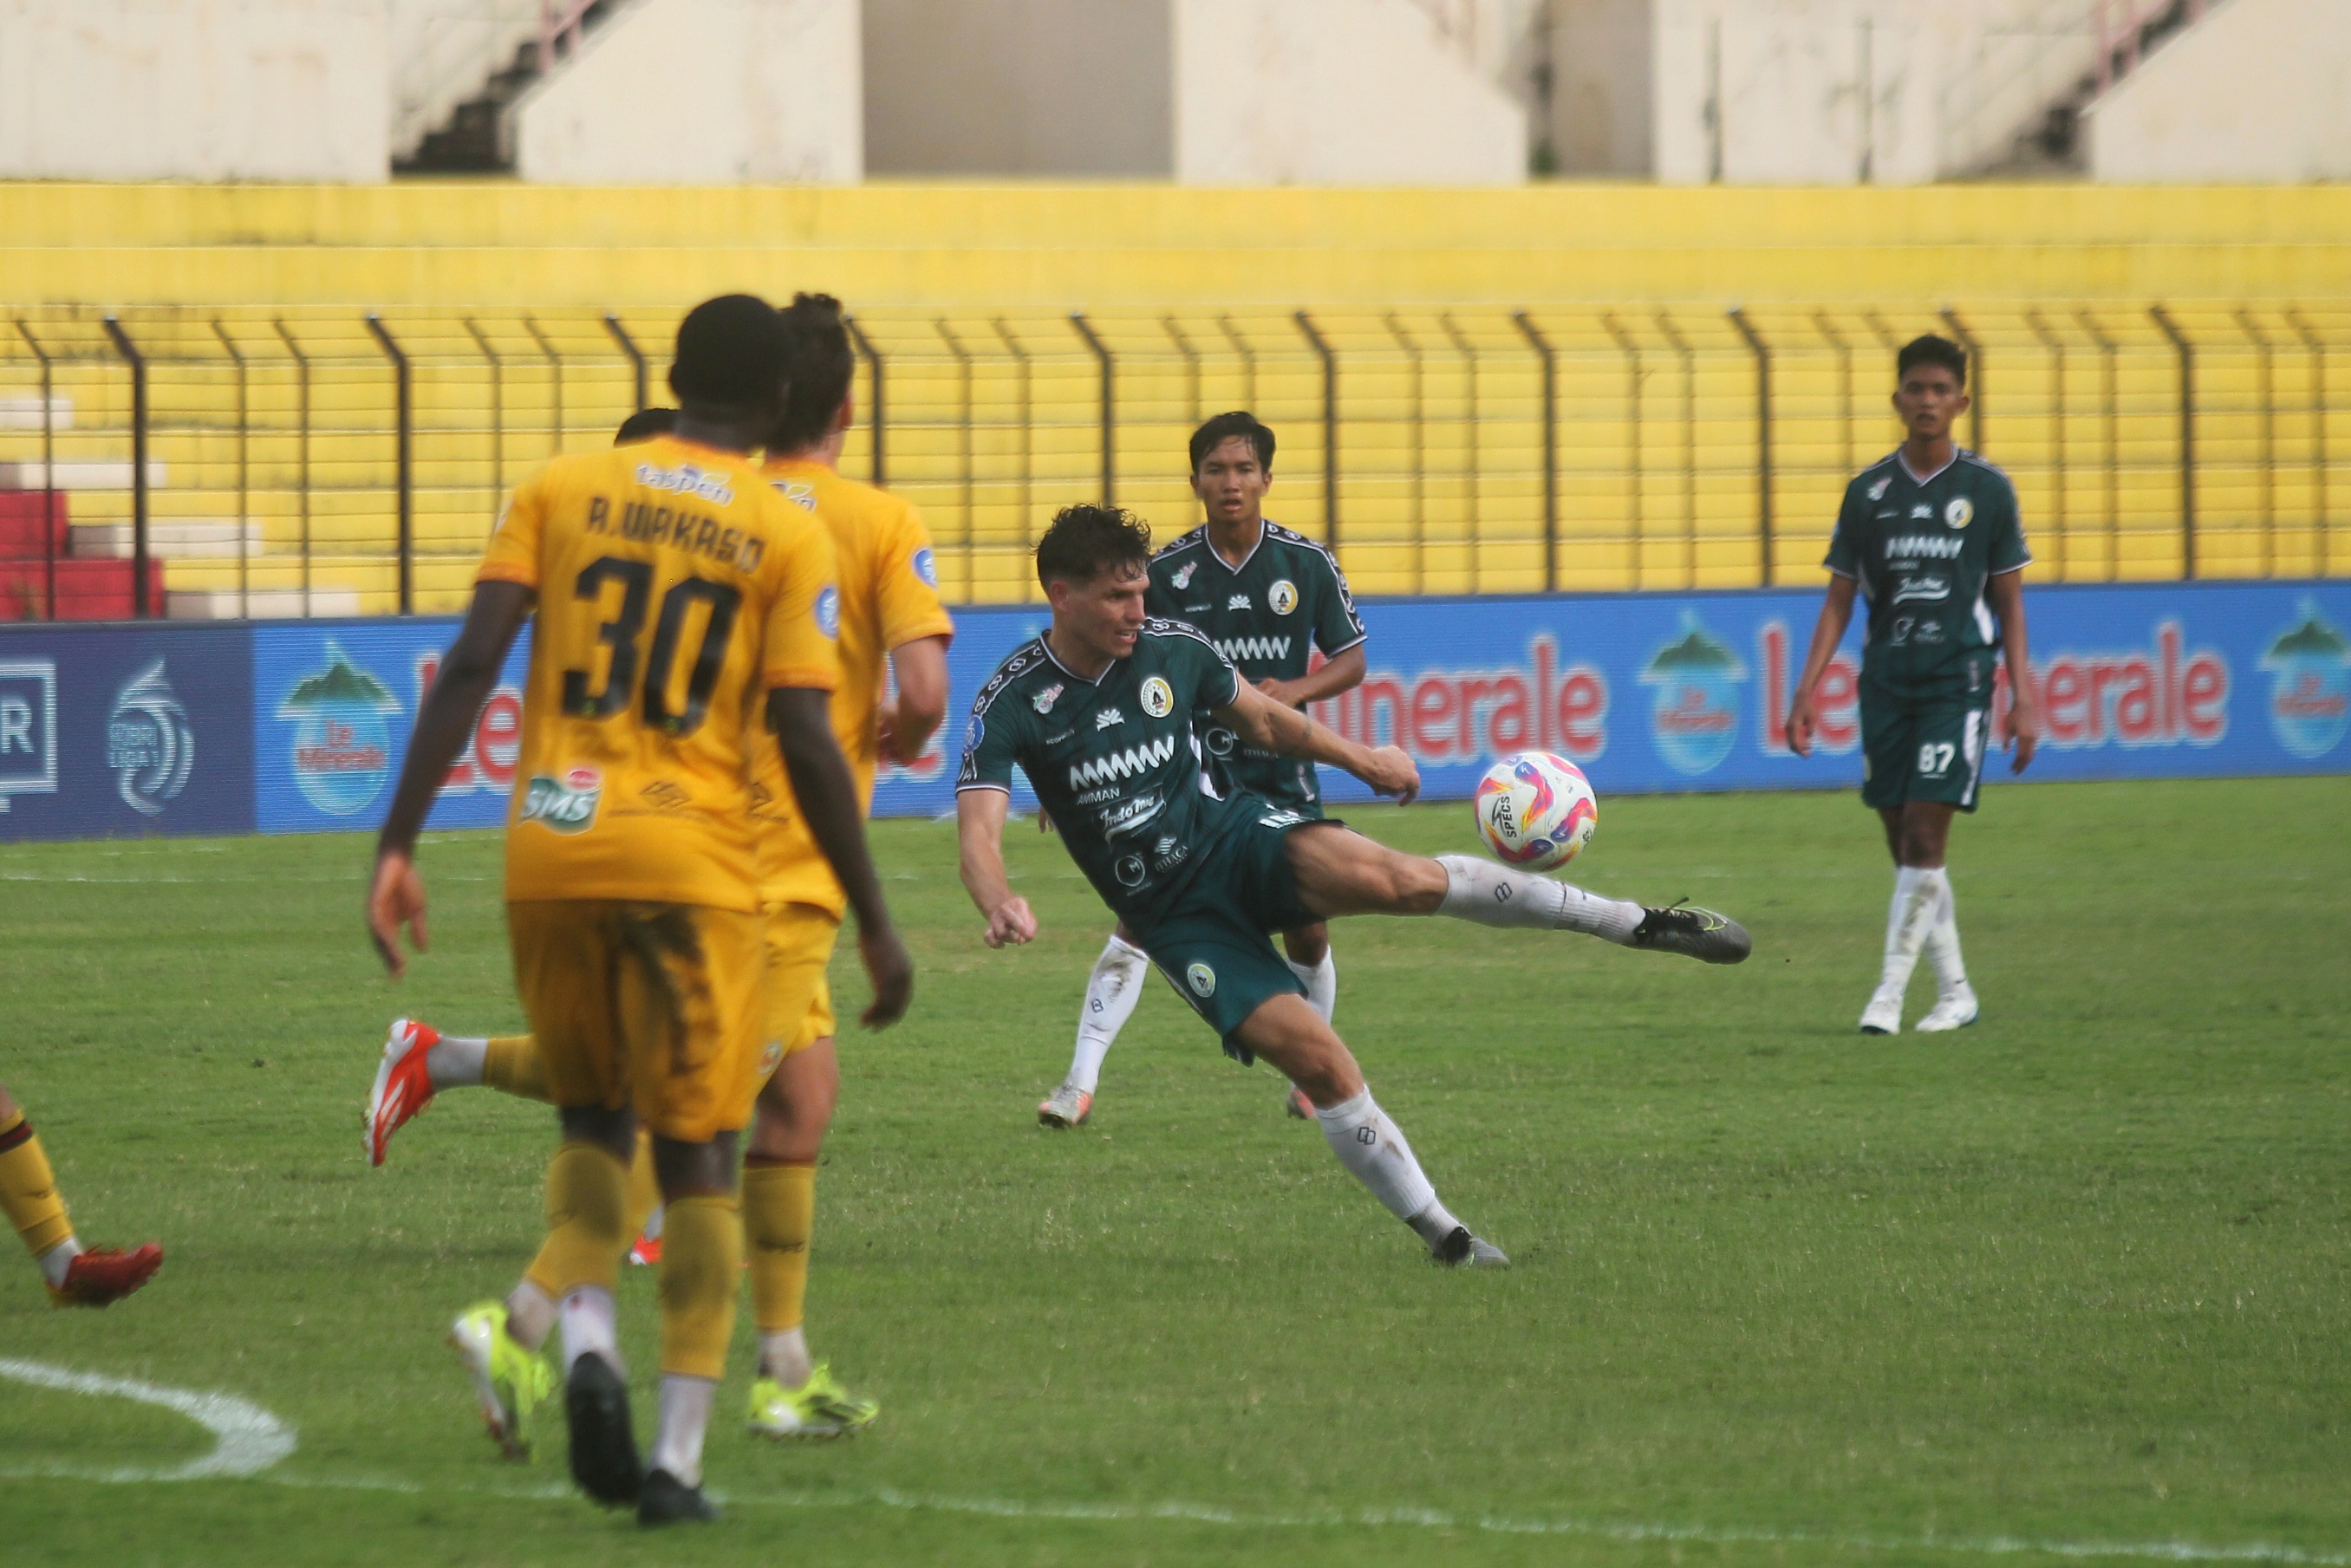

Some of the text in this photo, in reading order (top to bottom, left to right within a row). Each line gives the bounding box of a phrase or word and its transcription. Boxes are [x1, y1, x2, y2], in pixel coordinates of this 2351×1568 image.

[561, 555, 742, 738] 30
[1760, 626, 1862, 753] Le
[1918, 743, 1955, 772] 87
[1078, 788, 1120, 805] AMMAN
[1501, 796, 1517, 838] SPECS
